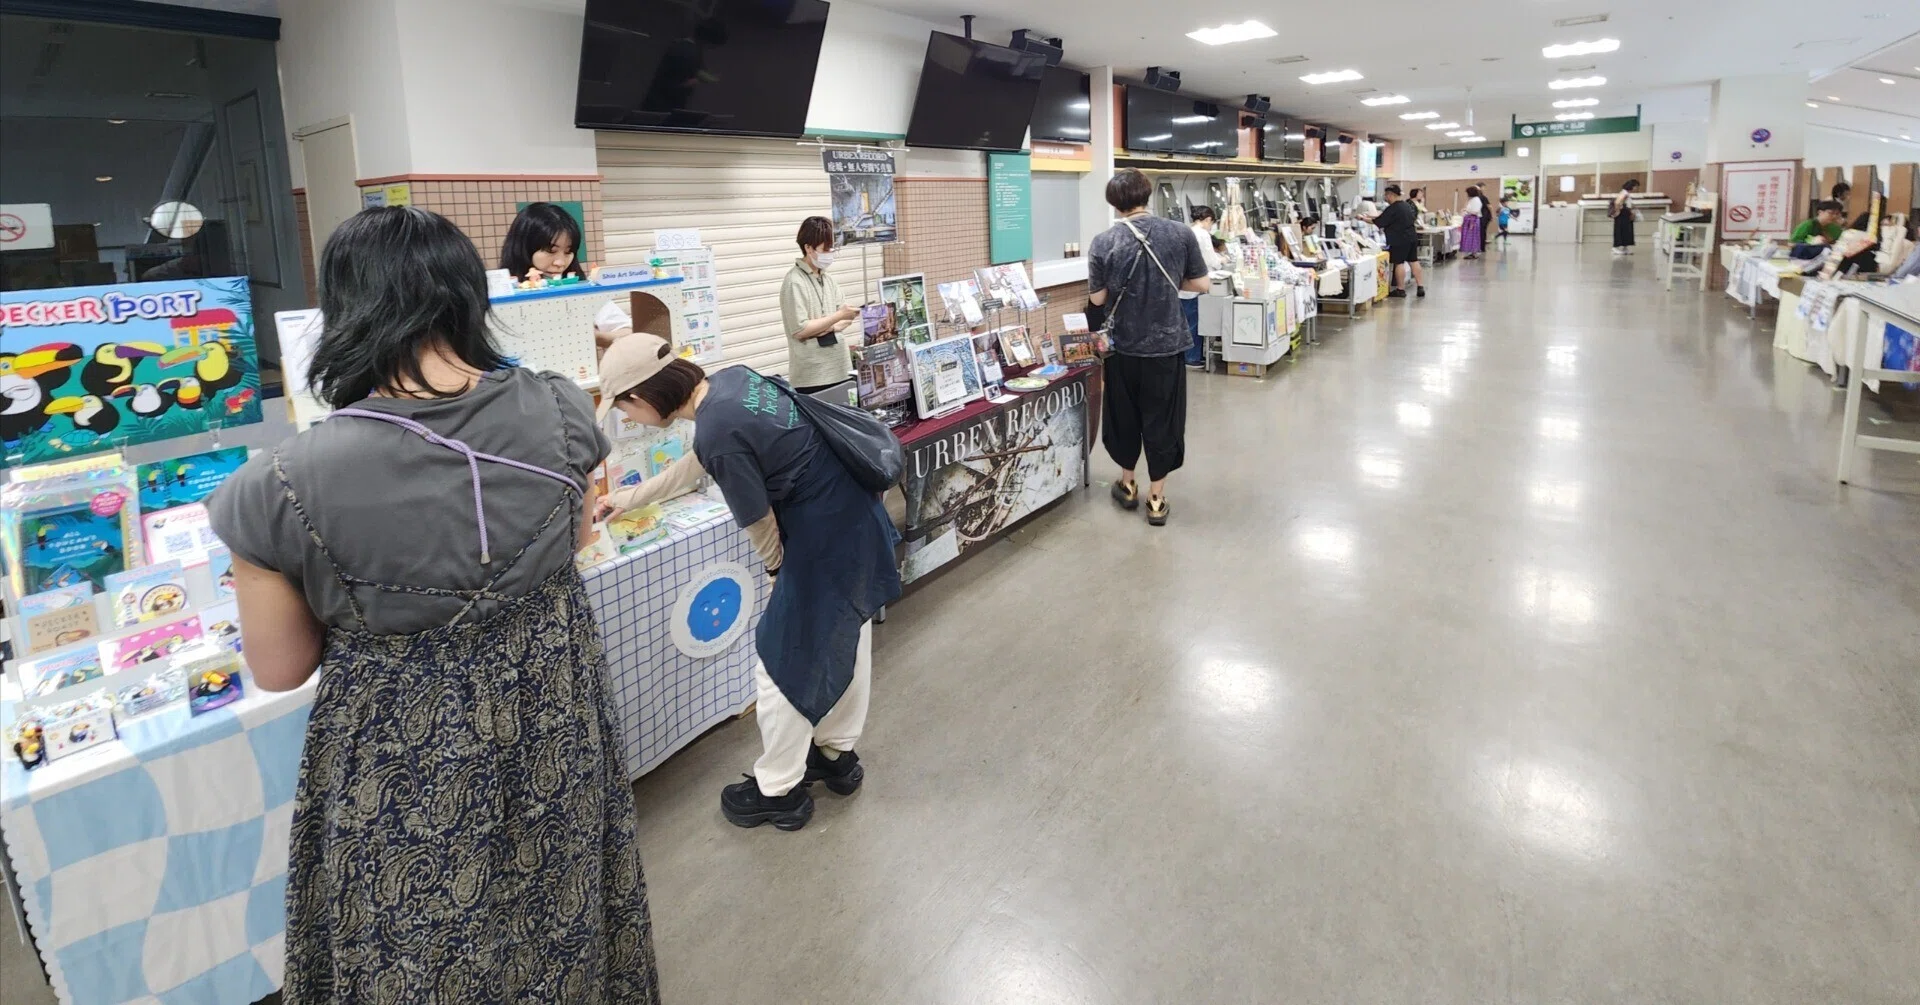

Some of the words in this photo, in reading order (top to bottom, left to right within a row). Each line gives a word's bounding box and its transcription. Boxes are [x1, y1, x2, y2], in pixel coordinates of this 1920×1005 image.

[628, 269, 648, 277] Studio
[110, 293, 196, 319] PORT
[743, 383, 760, 416] Above
[761, 400, 778, 416] be
[912, 416, 1003, 479] URBEX
[1006, 381, 1085, 436] RECORD
